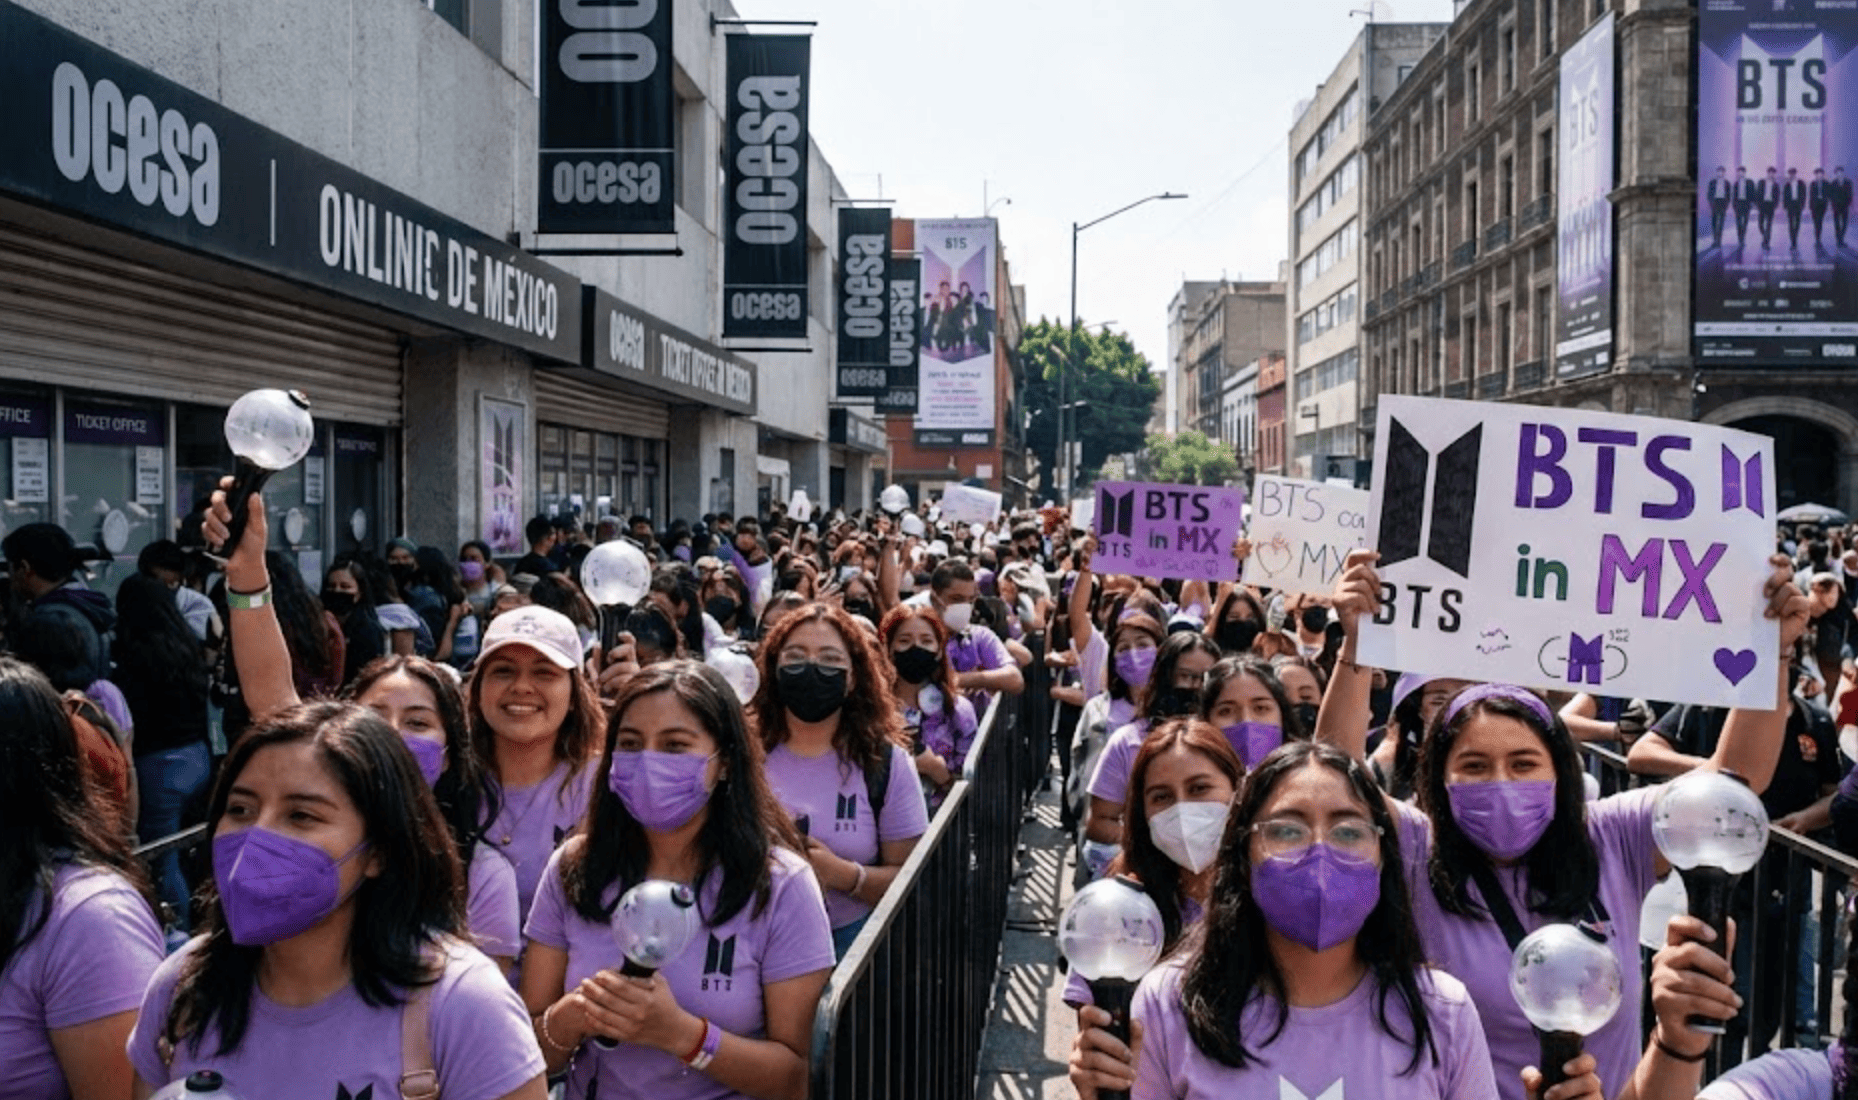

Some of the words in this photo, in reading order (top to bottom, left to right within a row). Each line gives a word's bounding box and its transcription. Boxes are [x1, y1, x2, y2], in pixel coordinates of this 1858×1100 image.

[1737, 59, 1827, 109] BTS
[52, 61, 220, 227] ocesa
[736, 75, 800, 244] ocesa
[553, 160, 661, 204] ocesa
[447, 238, 479, 314] DE
[484, 254, 557, 340] MÉXICO
[731, 292, 800, 320] ocesa
[844, 234, 885, 338] ocesa
[0, 407, 31, 424] FFICE
[75, 414, 110, 430] TICKET
[112, 419, 147, 433] OFFICE
[1514, 423, 1695, 520] BTS
[1145, 490, 1210, 522] BTS
[1260, 481, 1324, 522] BTS
[1149, 527, 1168, 549] in
[1177, 526, 1221, 554] MX
[1516, 543, 1568, 601] in
[1596, 533, 1728, 623] MX
[1372, 581, 1463, 633] BTS
